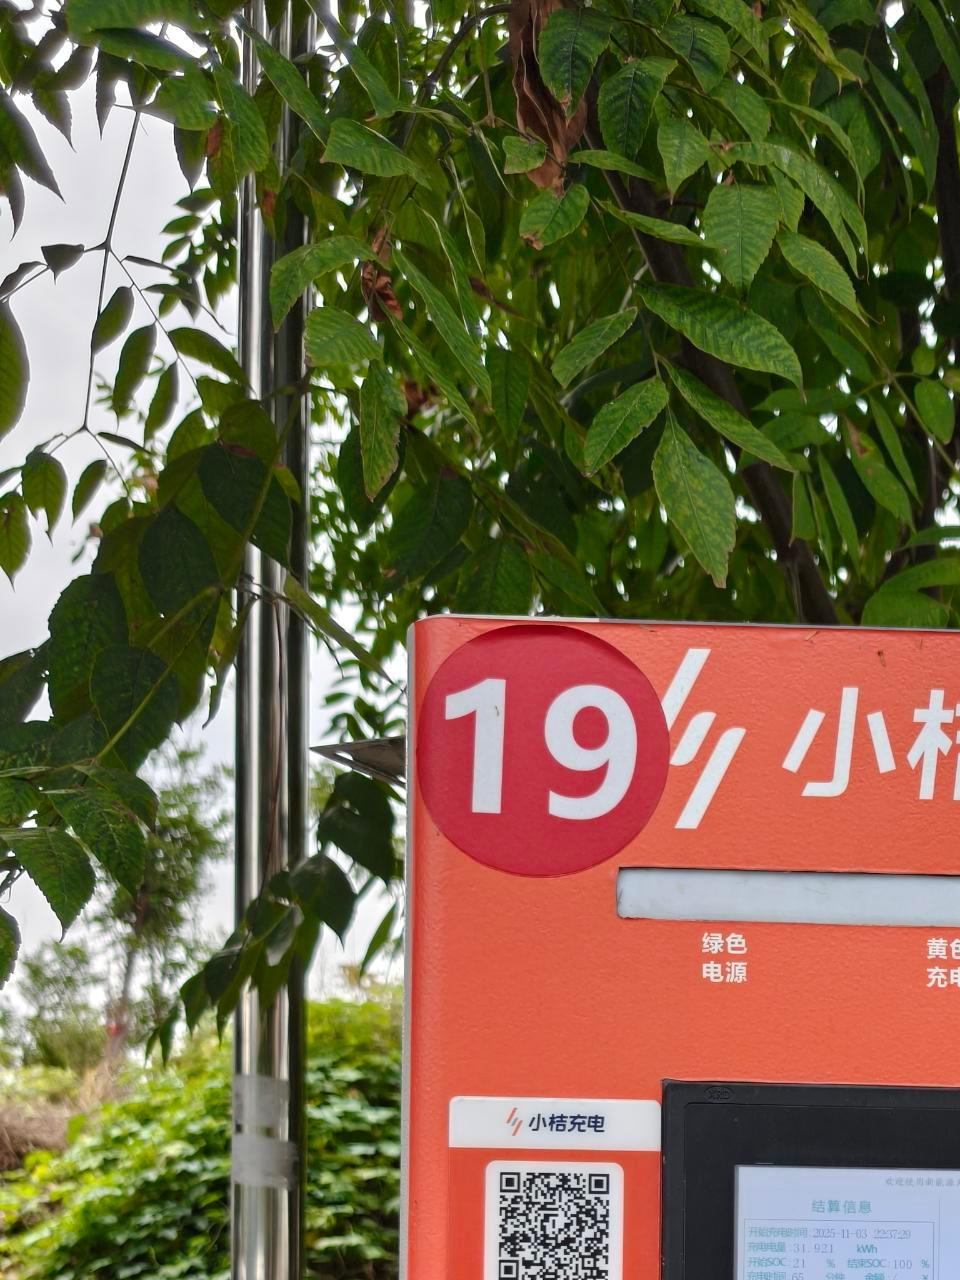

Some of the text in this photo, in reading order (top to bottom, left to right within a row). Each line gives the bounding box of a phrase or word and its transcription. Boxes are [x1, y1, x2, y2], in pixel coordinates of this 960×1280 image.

[444, 679, 638, 821] 19
[701, 932, 747, 955] 绿色
[701, 961, 747, 984] 电源
[528, 1113, 606, 1133] 小桔充电
[812, 1200, 872, 1214] 结算信息
[812, 1228, 867, 1239] 2025-11-03
[856, 1244, 878, 1253] kWh
[793, 1258, 806, 1269] 21
[826, 1259, 836, 1268] %
[894, 1259, 912, 1270] 100
[921, 1260, 930, 1269] %
